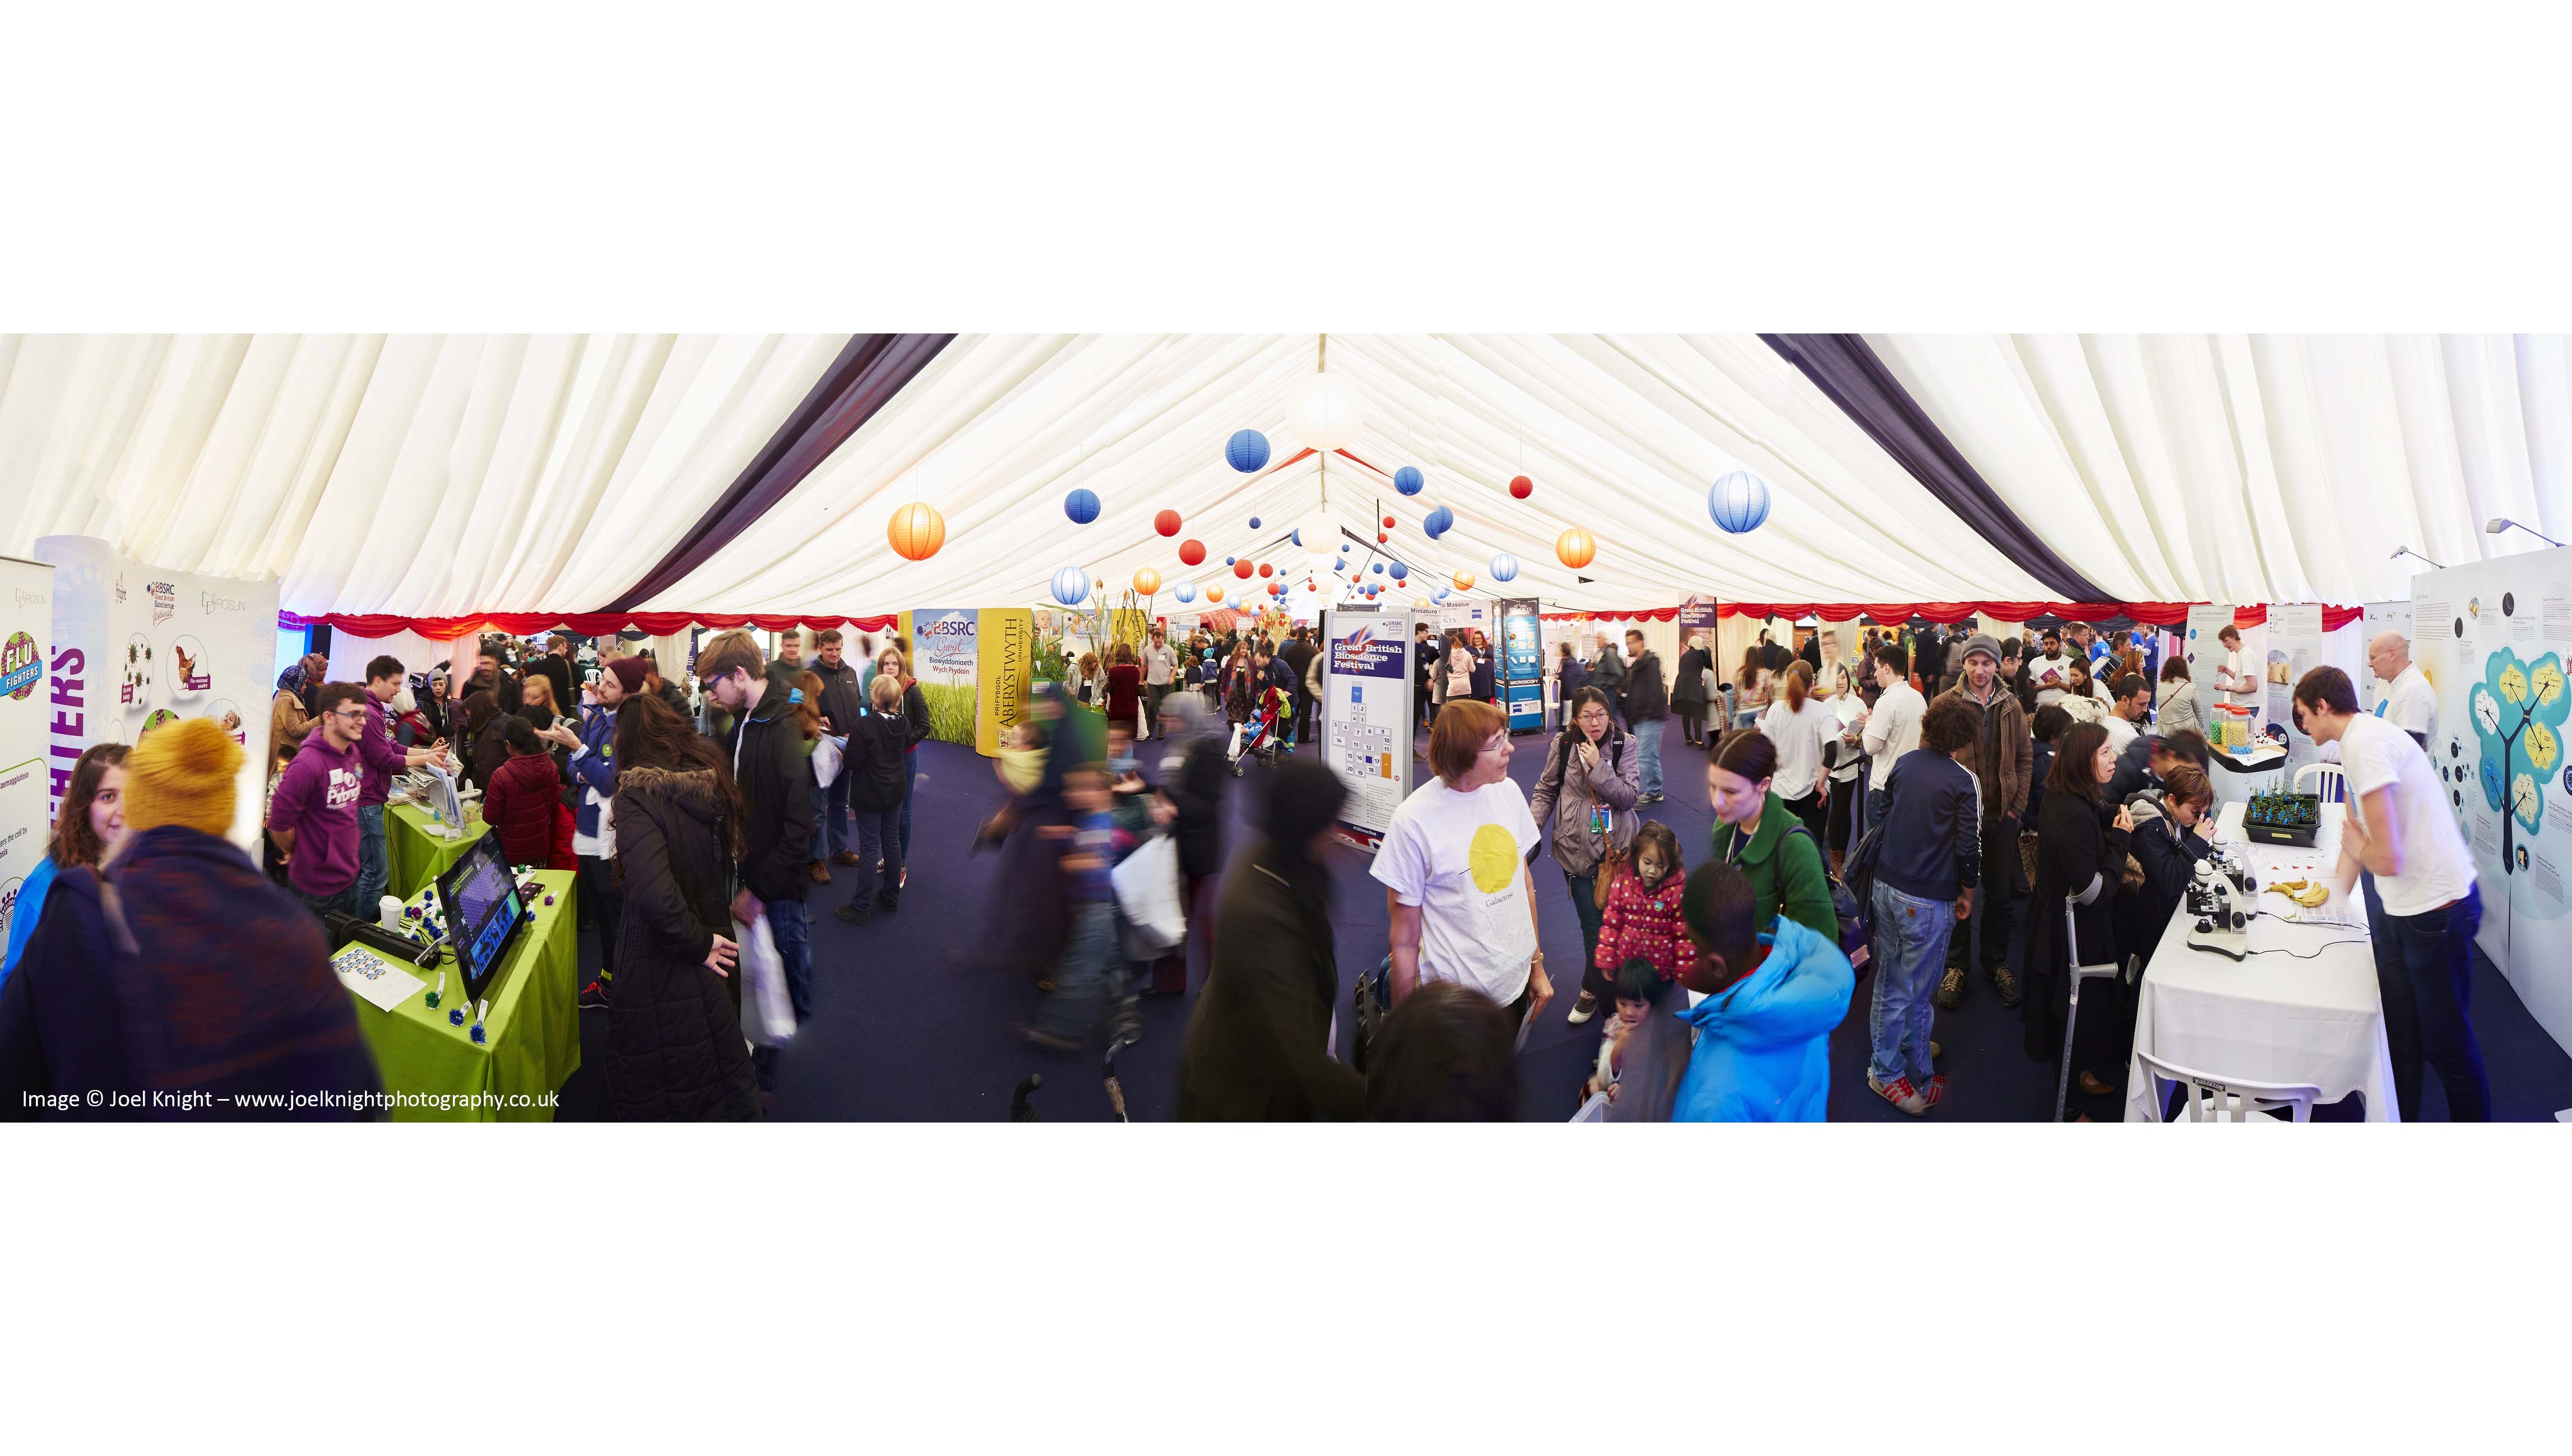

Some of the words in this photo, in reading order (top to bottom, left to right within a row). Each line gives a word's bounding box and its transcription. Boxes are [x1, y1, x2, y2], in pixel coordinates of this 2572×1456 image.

[155, 582, 175, 595] BBSRC
[154, 601, 174, 609] Bioscience
[934, 621, 975, 636] BBSRC
[1334, 643, 1363, 651] Great
[1365, 644, 1402, 653] British
[6, 642, 33, 673] FLU
[929, 657, 974, 666] Biowyddoniaeth
[1334, 652, 1388, 661] Bioscience
[933, 665, 947, 674] Wych
[1334, 661, 1375, 670] Festival
[999, 618, 1017, 727] ABERYSTWYTH
[6, 666, 38, 690] FIGHTERS
[0, 771, 29, 789] aemagglutinin
[22, 826, 27, 836] by
